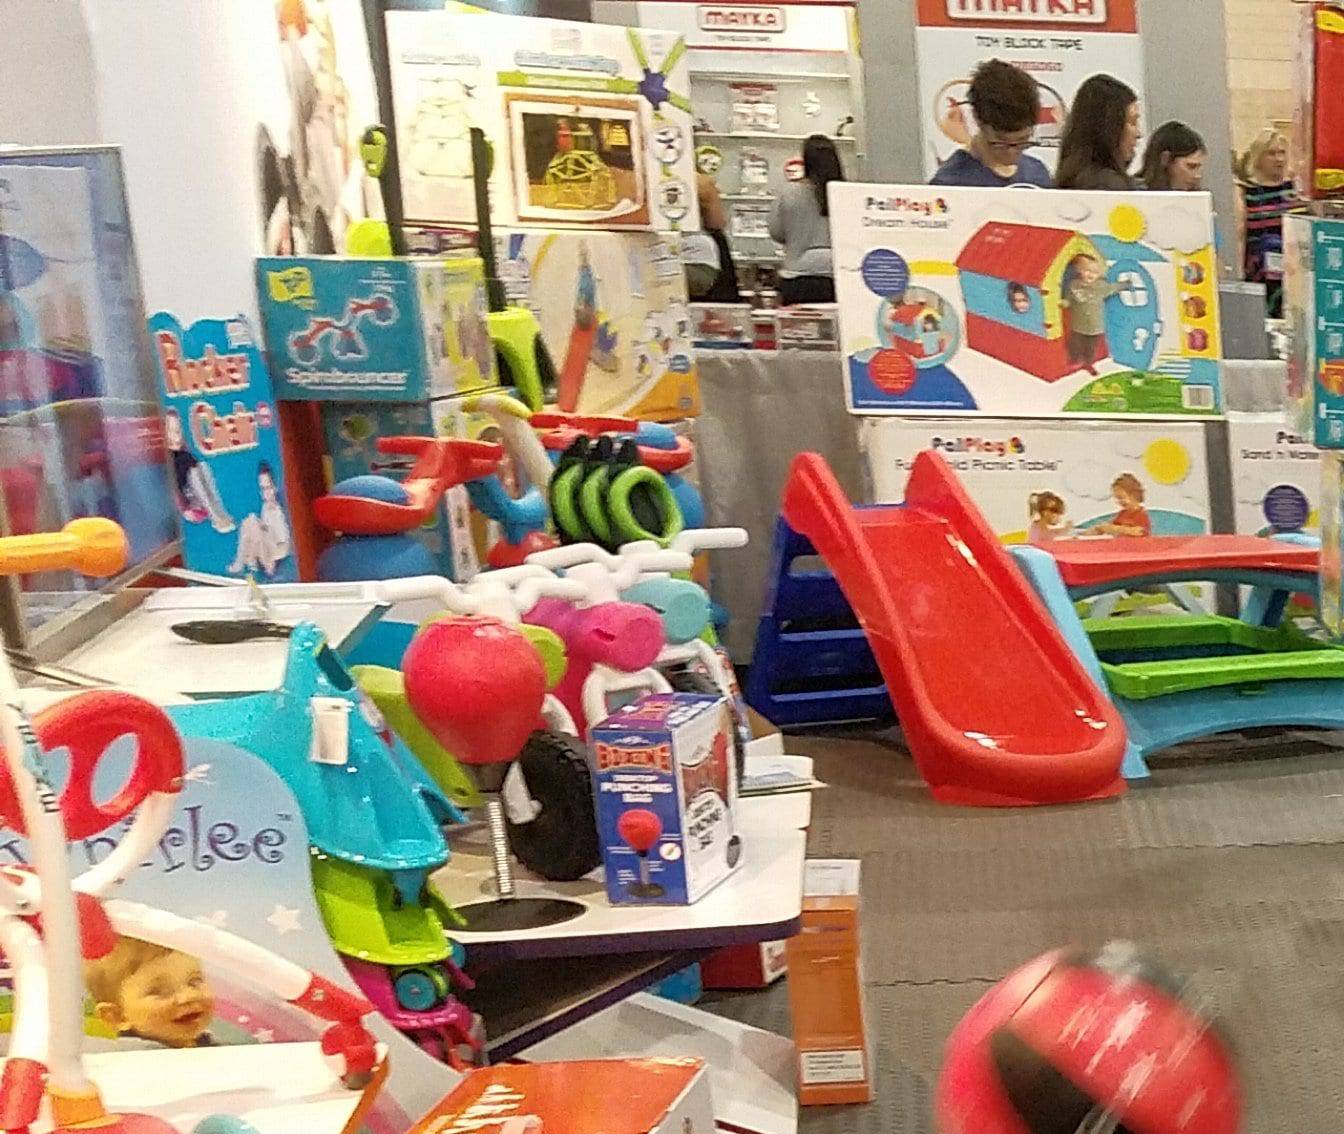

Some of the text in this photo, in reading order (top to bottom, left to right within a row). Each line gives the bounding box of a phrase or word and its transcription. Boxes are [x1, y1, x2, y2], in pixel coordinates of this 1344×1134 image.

[975, 35, 1083, 51] TOY BLOCK TAPE
